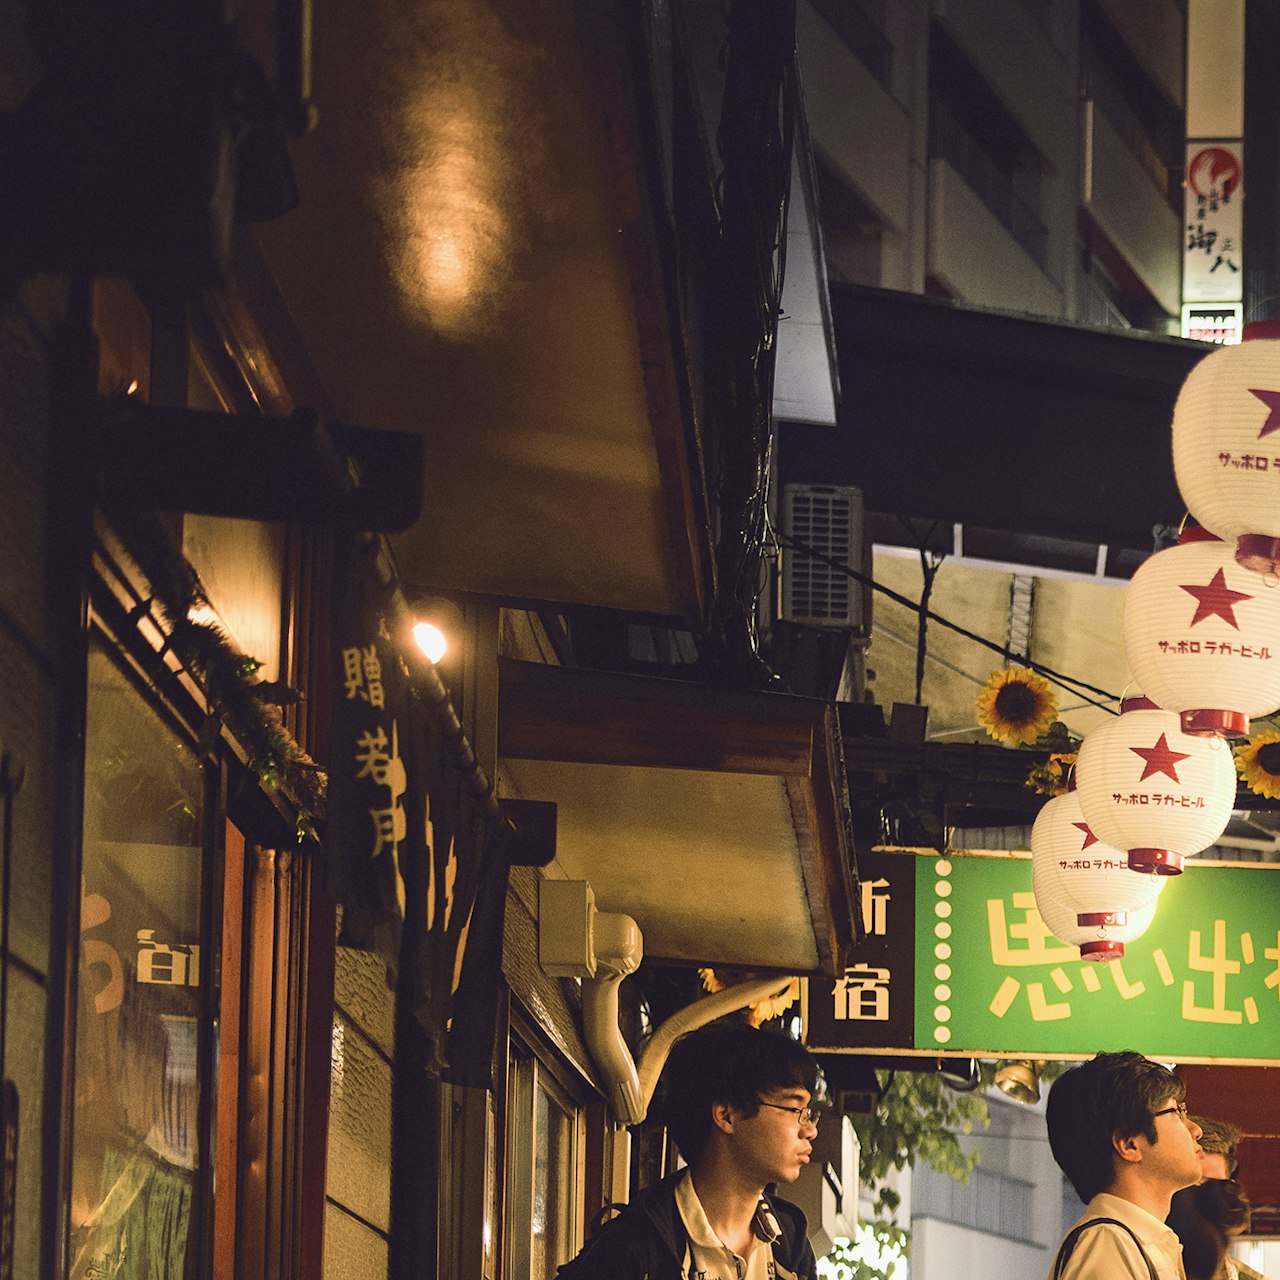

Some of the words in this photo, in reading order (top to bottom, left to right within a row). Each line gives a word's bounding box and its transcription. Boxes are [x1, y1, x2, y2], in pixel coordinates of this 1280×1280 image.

[1218, 452, 1269, 472] サッポロ
[1158, 640, 1201, 654] サッポロ
[1205, 641, 1272, 660] ラガービール
[1112, 793, 1149, 805] サッポロ
[1152, 794, 1206, 808] ラガービール
[1059, 860, 1090, 870] サッポロ
